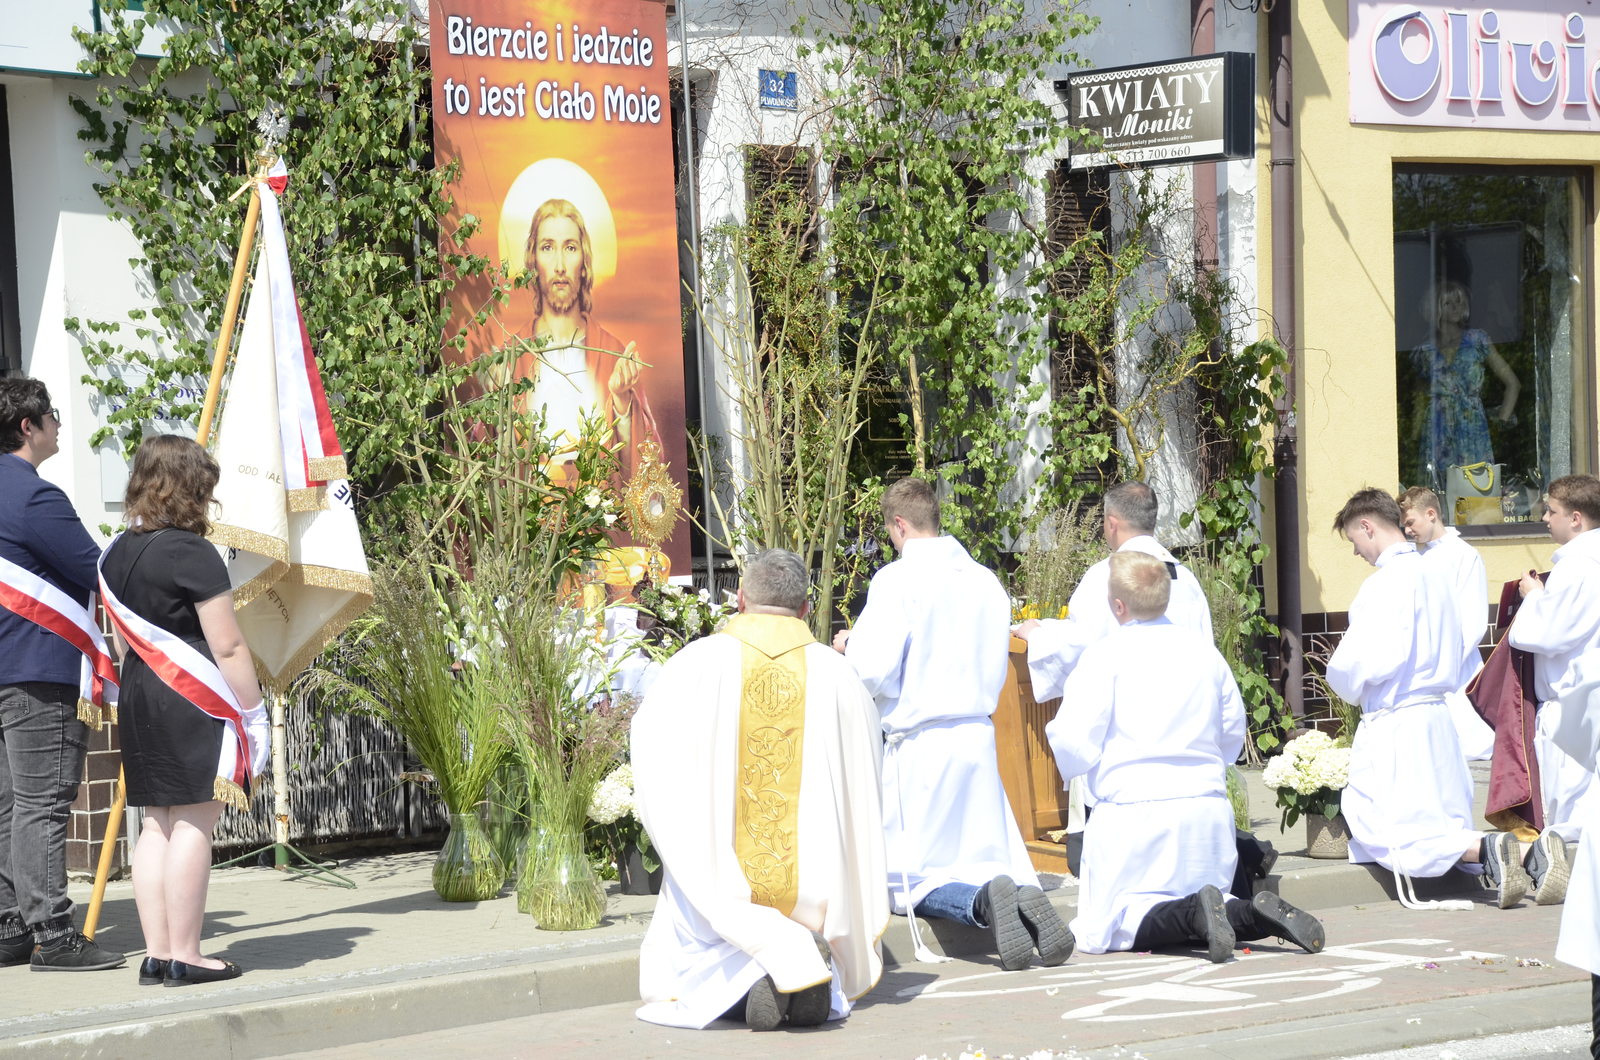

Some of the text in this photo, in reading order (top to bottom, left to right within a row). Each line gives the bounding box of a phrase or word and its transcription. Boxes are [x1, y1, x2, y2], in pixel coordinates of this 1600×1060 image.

[447, 15, 654, 67] Bierzcie i jedzcie
[443, 76, 661, 124] to jest Ciało Moje
[769, 79, 785, 94] 32
[1078, 70, 1220, 119] KWIATY
[1102, 108, 1194, 139] u Moniki
[1125, 145, 1190, 162] 513 700 660
[1132, 138, 1148, 146] kwiaty
